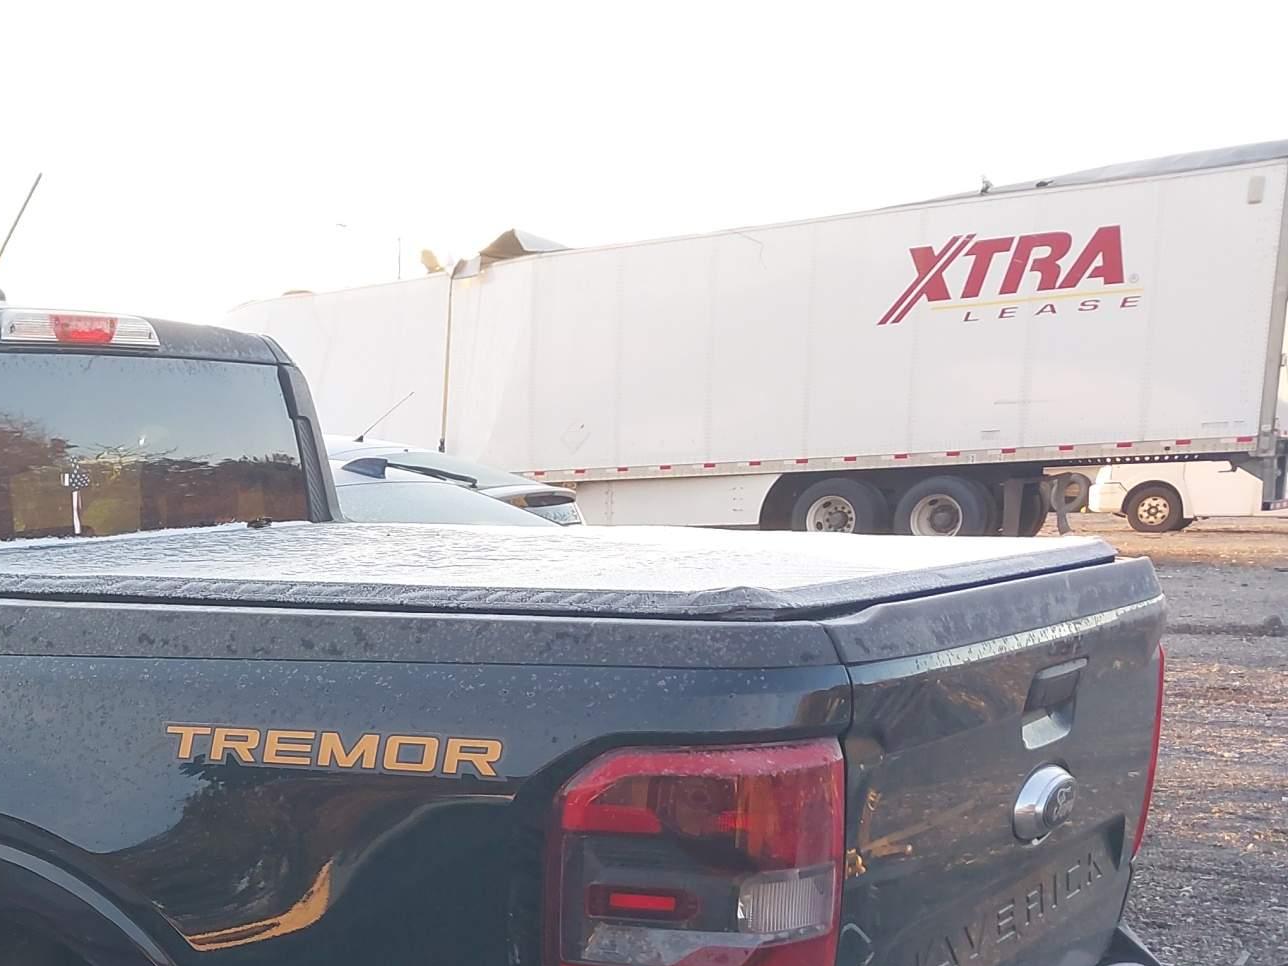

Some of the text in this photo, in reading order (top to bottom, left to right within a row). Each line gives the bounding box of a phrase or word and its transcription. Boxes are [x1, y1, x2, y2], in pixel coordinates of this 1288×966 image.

[876, 224, 1126, 326] XTRA
[962, 295, 1143, 322] LEASE
[165, 724, 505, 778] TREMOR
